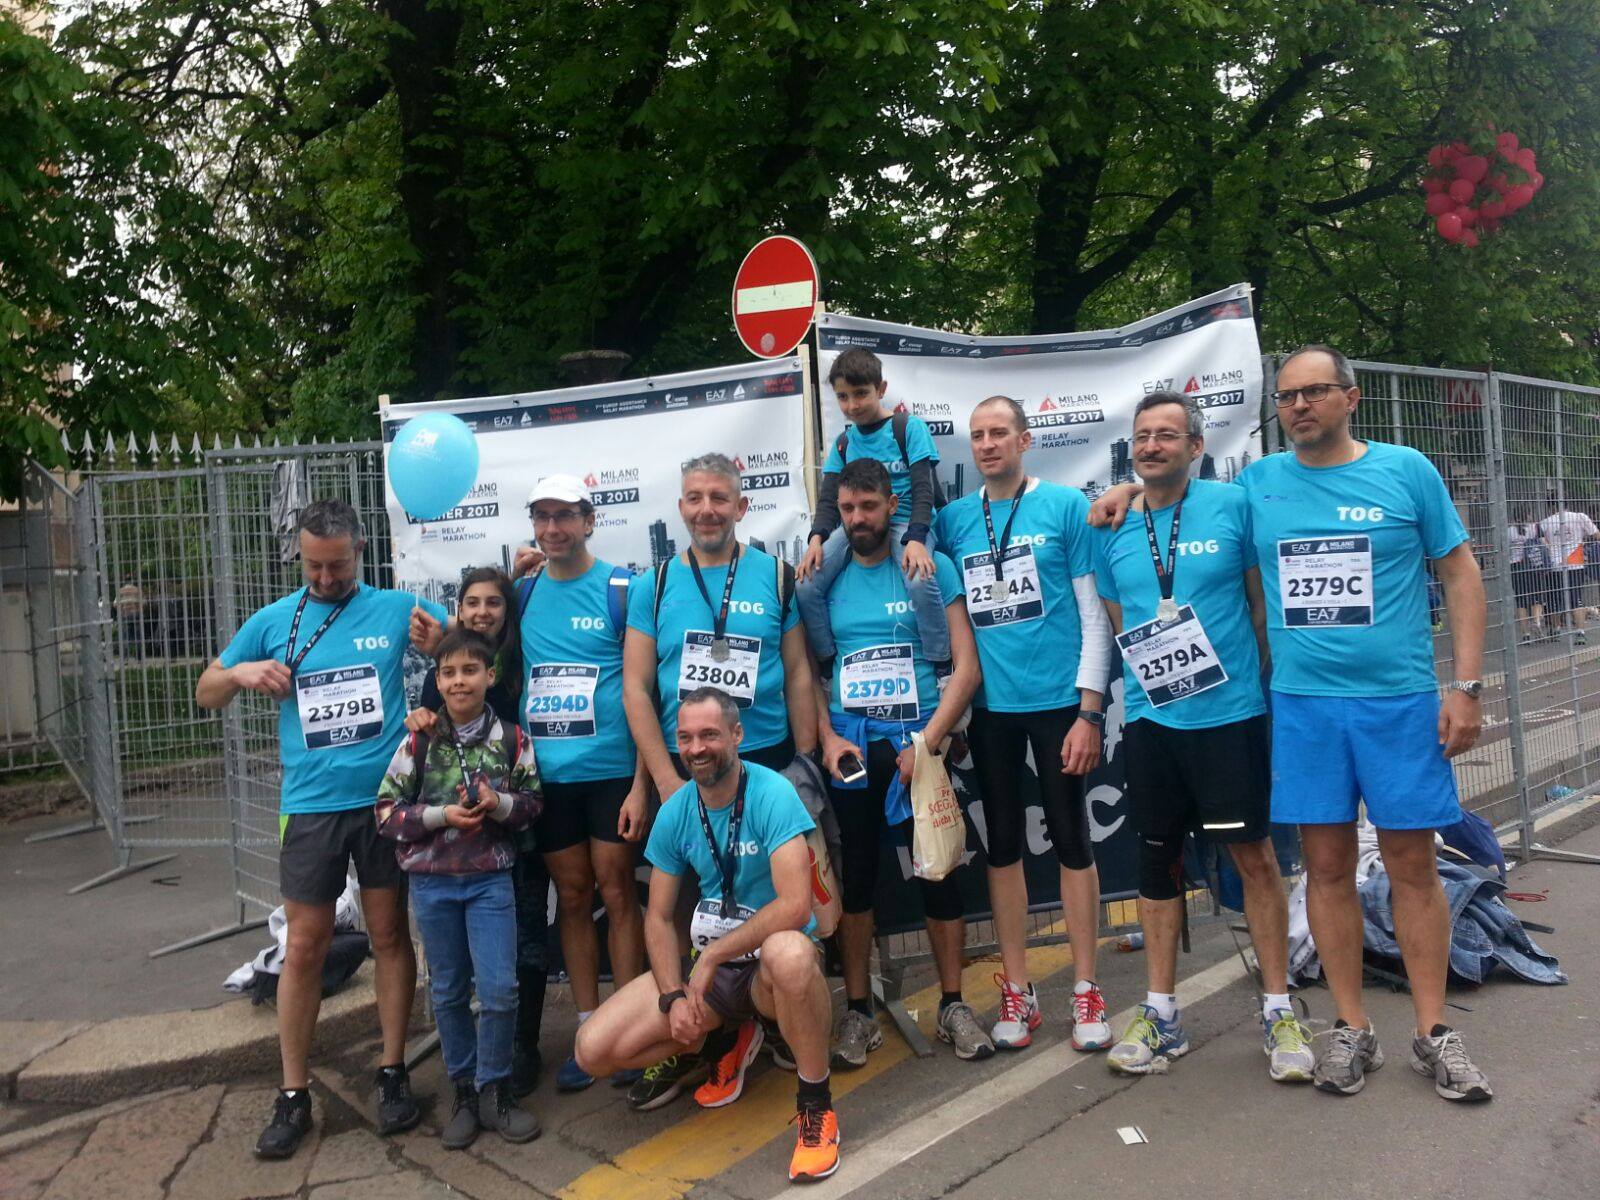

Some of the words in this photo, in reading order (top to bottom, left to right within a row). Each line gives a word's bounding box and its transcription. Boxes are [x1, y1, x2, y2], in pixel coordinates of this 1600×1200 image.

[1202, 370, 1243, 382] MILANO
[1142, 378, 1174, 394] EA7
[705, 389, 726, 401] EA7
[1058, 393, 1099, 404] MILANO
[1211, 392, 1242, 406] 2017
[912, 402, 950, 412] MILANO
[493, 415, 514, 427] EA7
[1028, 414, 1066, 427] SHER
[1069, 411, 1101, 423] 2017
[1205, 420, 1231, 429] ATHON
[928, 422, 951, 434] 017
[1041, 432, 1069, 441] RELAY
[1041, 438, 1089, 449] MARATHON
[747, 451, 788, 463] MILANO
[601, 468, 639, 479] MILANO
[755, 474, 787, 488] 2017
[470, 482, 498, 494] LANO
[607, 490, 637, 503] 2017
[467, 504, 497, 518] 2017
[747, 503, 777, 513] ATHON
[1337, 506, 1385, 522] TOG
[441, 526, 466, 535] RELAY
[442, 532, 486, 542] MARATHON
[1011, 534, 1047, 546] TOG
[1177, 539, 1220, 556] TOG
[1291, 543, 1312, 552] EA7
[973, 555, 990, 565] EA7
[971, 576, 1035, 603] 234A
[1288, 576, 1363, 597] 2379C
[729, 600, 764, 615] TOG
[992, 605, 1019, 621] EA7
[1307, 608, 1341, 620] EA7
[571, 617, 605, 630] TOG
[1128, 629, 1144, 642] EA7
[353, 635, 389, 651] TOG
[1144, 637, 1162, 647] RELAY
[1146, 637, 1179, 652] MARATHON
[1138, 642, 1208, 681] 2379A
[309, 674, 327, 685] EA7
[343, 669, 365, 678] MILANO
[685, 664, 750, 688] 2380A
[846, 678, 911, 698] 2379D
[1168, 676, 1196, 695] EA7
[323, 688, 357, 697] MARATHON
[308, 697, 376, 723] 2379B
[529, 695, 589, 714] 2394D
[867, 705, 893, 717] EA7
[329, 726, 359, 741] EA7
[547, 722, 571, 733] EA7
[708, 903, 720, 912] EA
